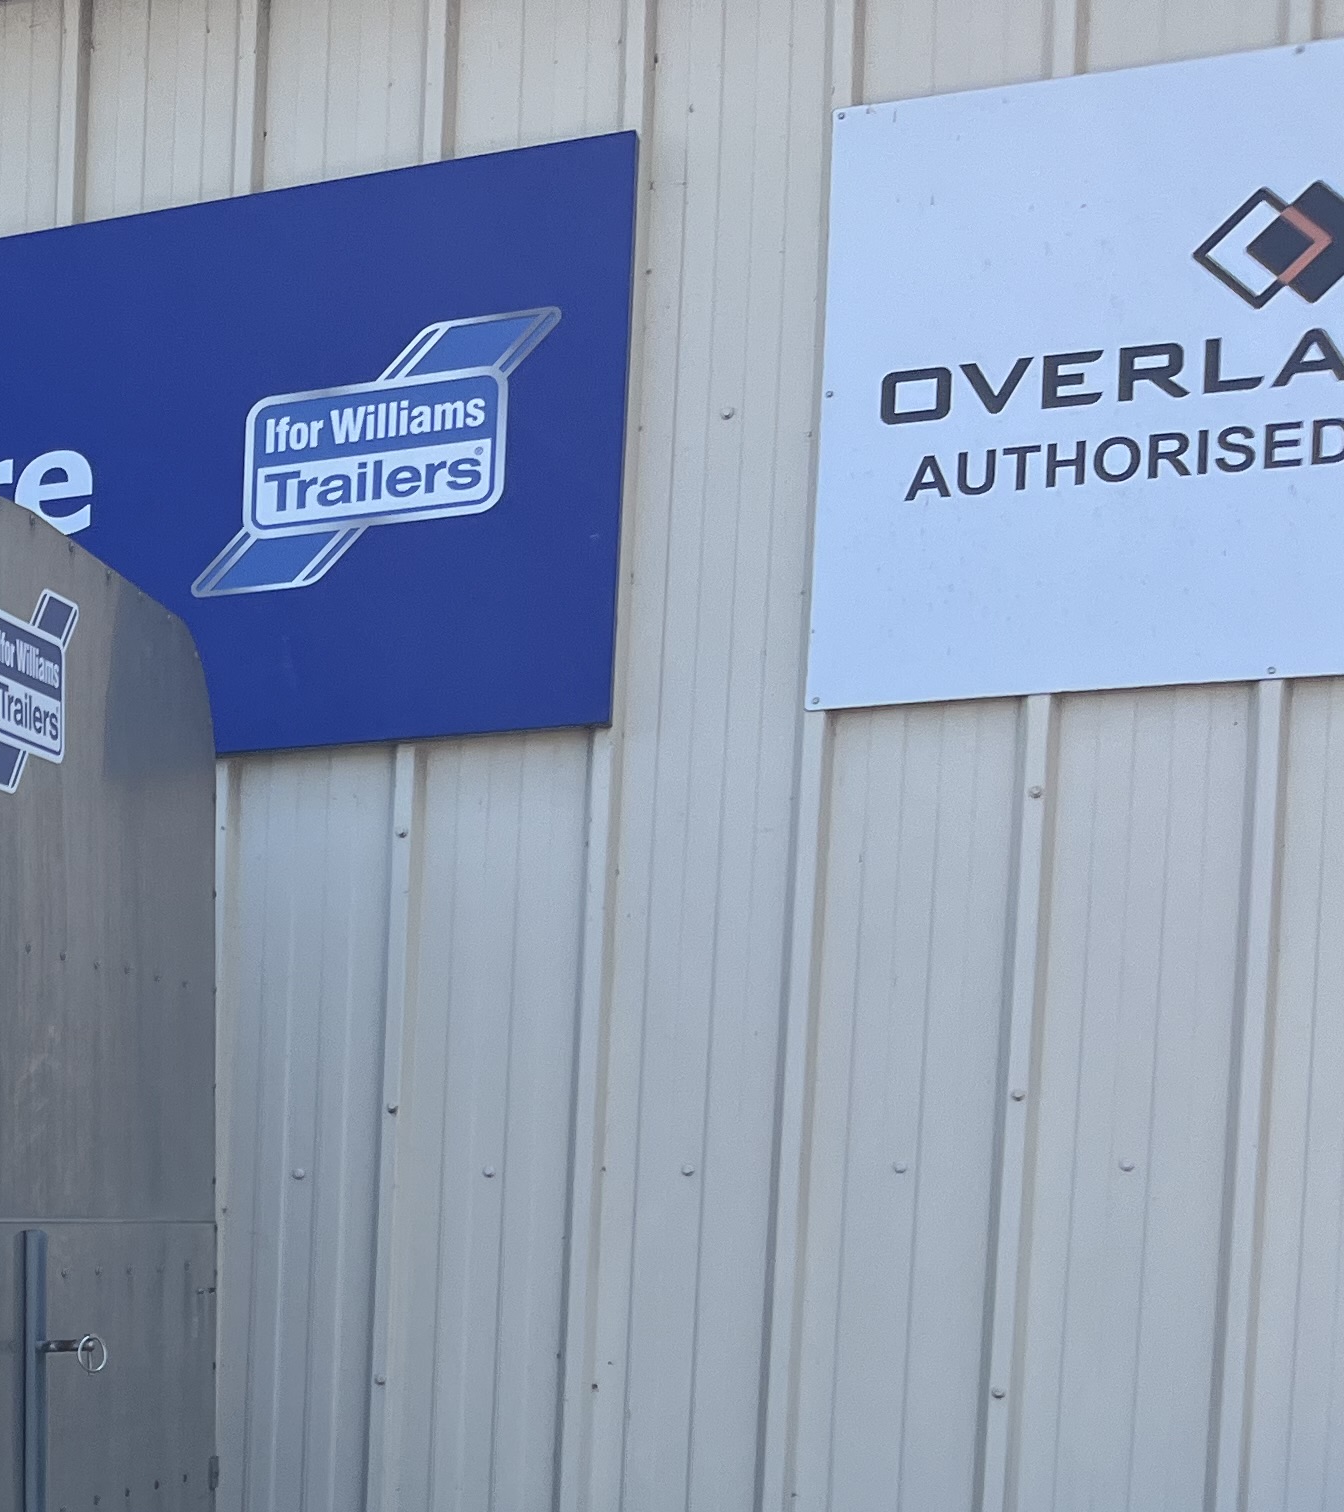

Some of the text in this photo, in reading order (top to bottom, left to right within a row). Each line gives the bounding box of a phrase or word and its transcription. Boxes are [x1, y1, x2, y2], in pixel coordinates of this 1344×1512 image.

[264, 397, 486, 454] Ifor Williams
[264, 457, 483, 513] Trailers
[903, 417, 1344, 502] AUTHORISED
[15, 638, 61, 689] Williams
